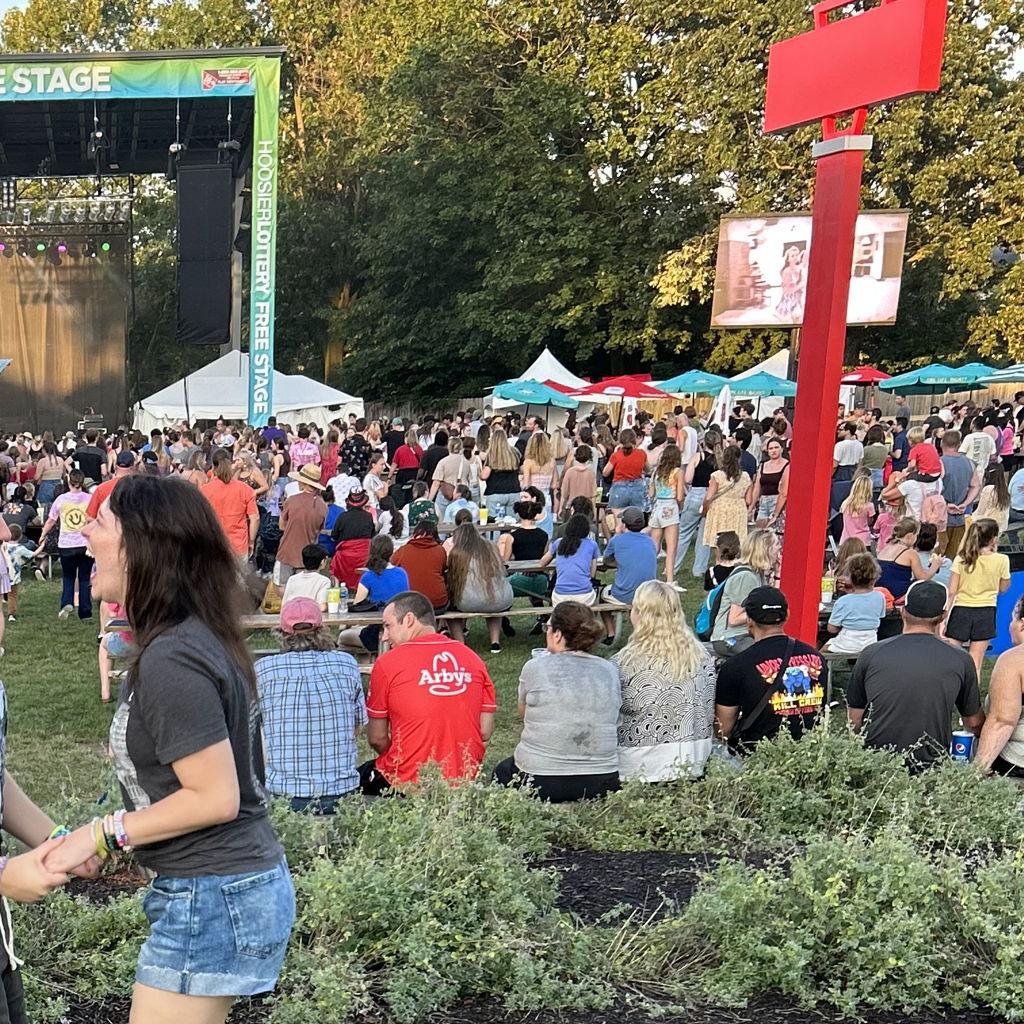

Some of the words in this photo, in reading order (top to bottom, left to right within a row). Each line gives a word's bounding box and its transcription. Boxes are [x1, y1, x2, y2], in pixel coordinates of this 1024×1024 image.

[12, 66, 112, 94] STAGE
[255, 140, 274, 295] HOOSIERLOTTERY
[254, 302, 270, 350] FREE
[253, 353, 270, 414] STAGE
[418, 667, 473, 687] Arby's
[773, 700, 797, 711] KILL
[799, 697, 823, 707] CREW
